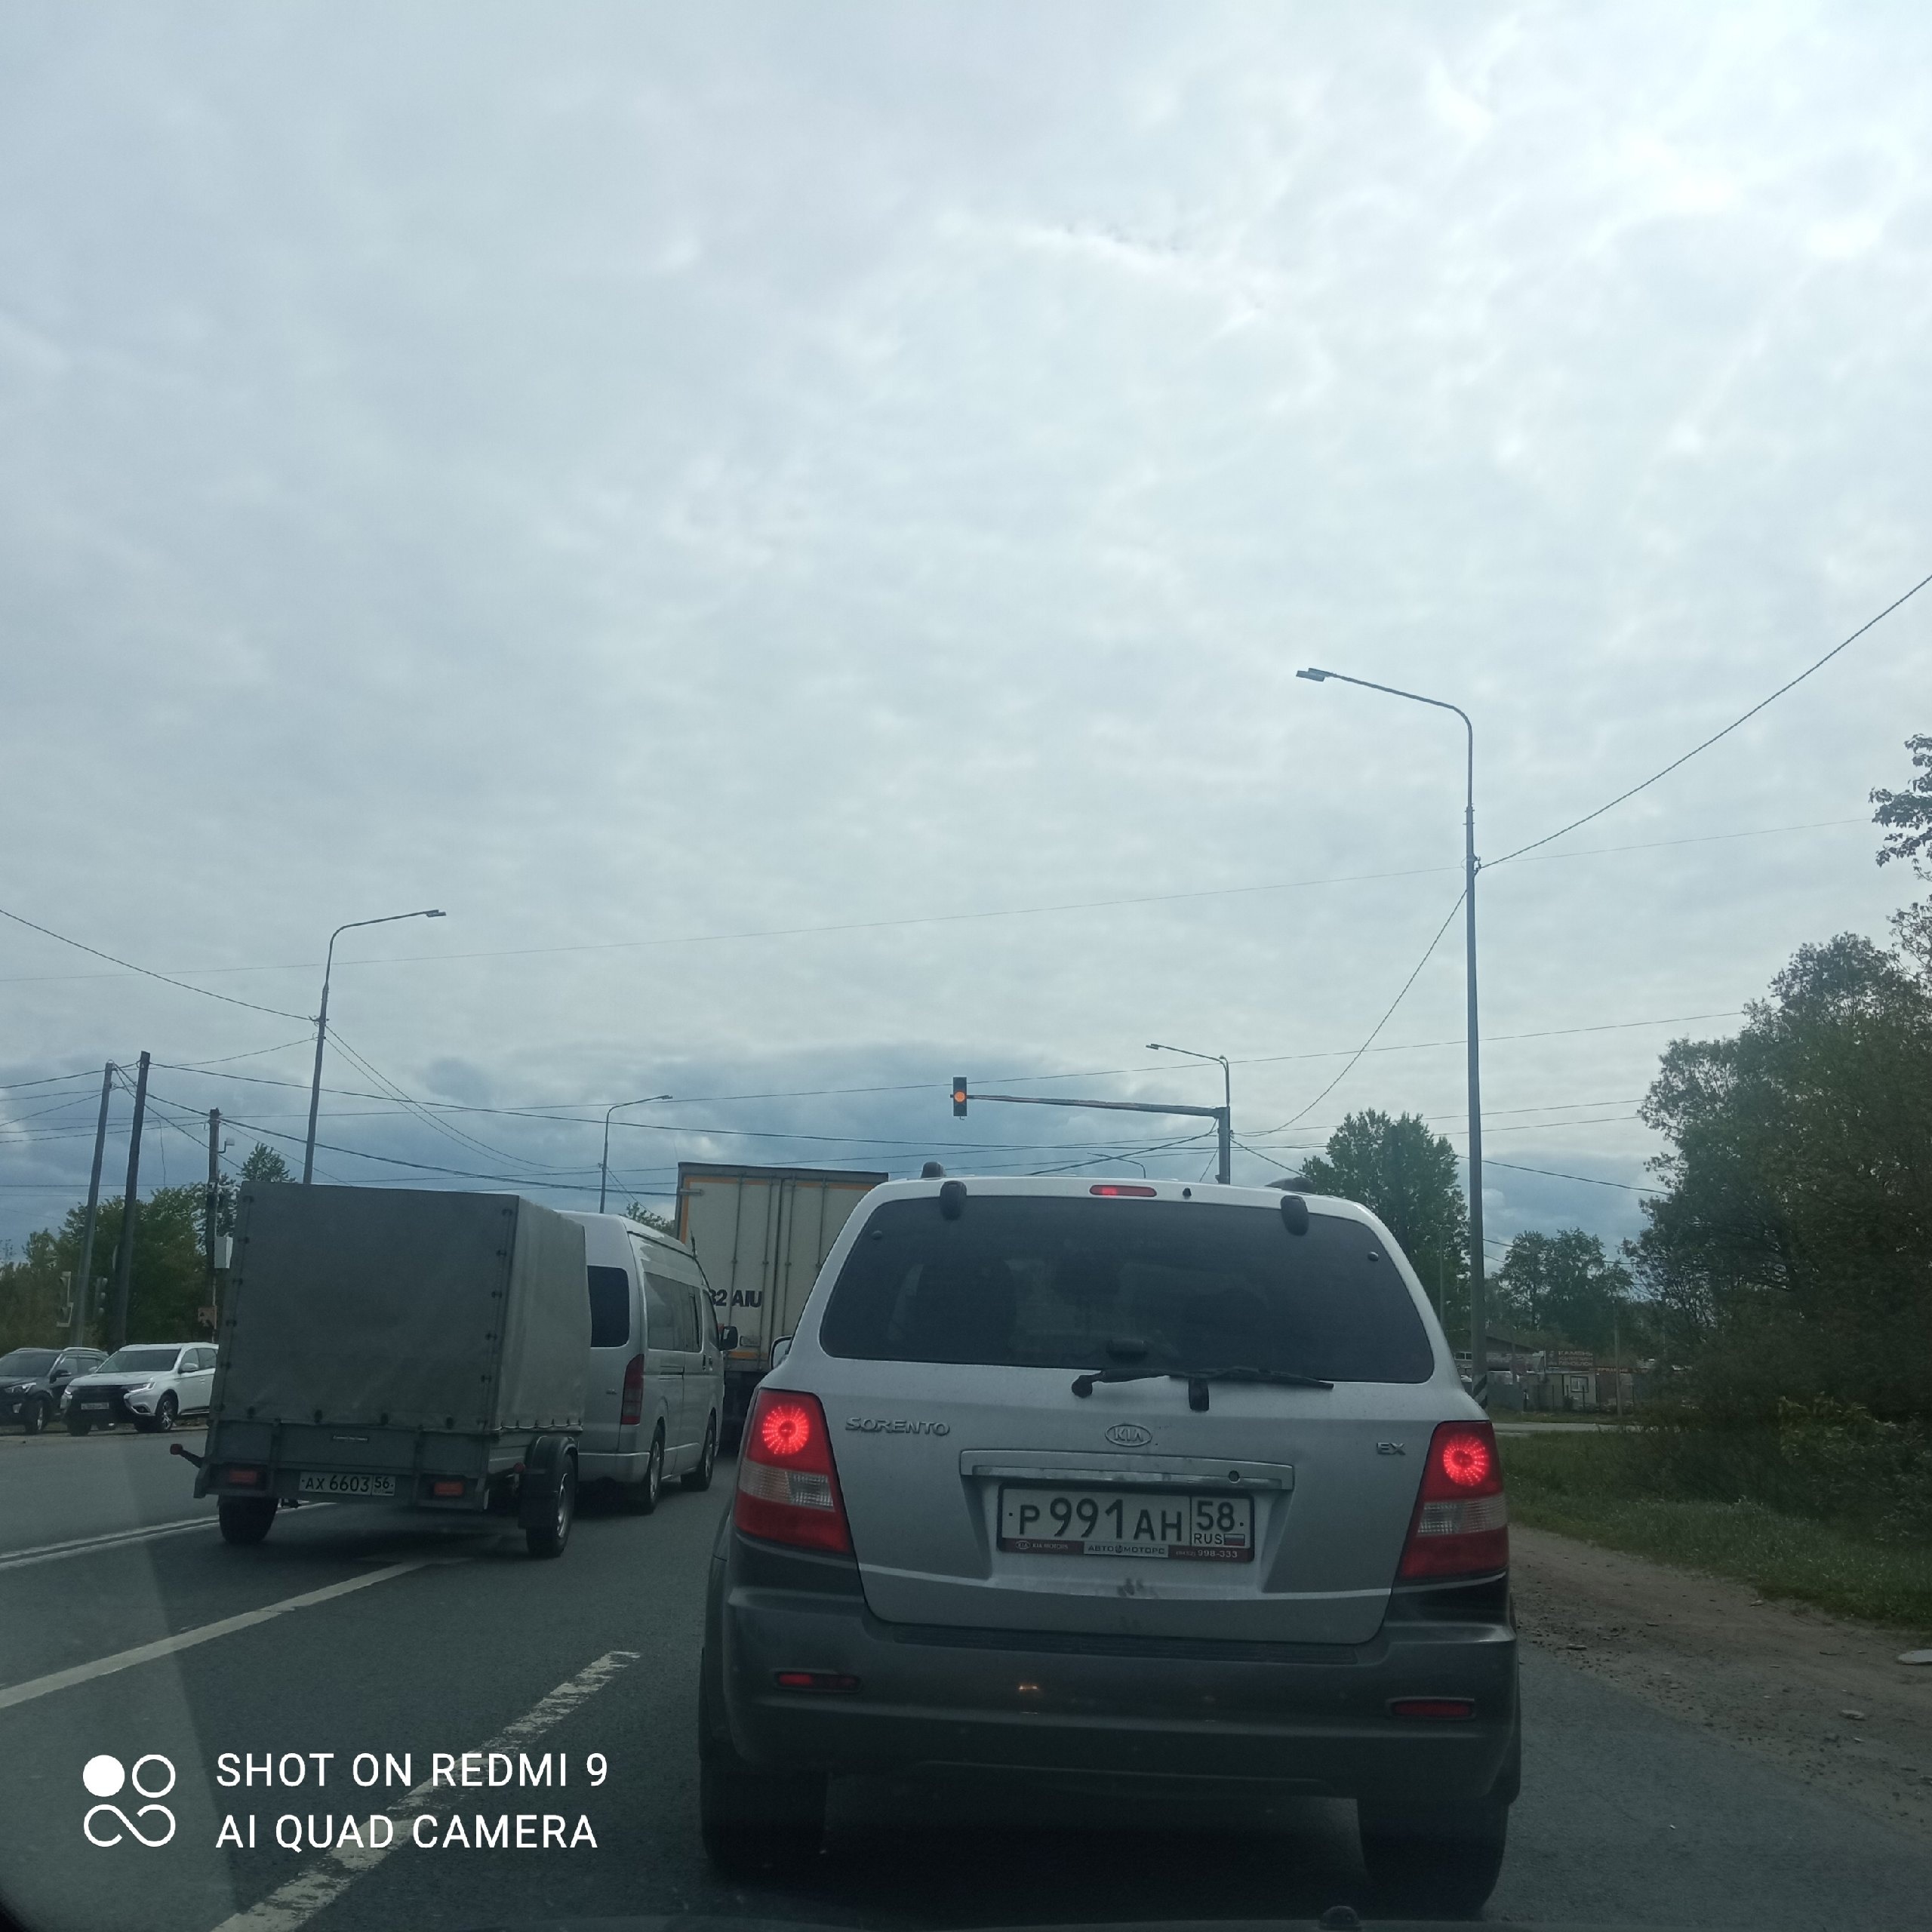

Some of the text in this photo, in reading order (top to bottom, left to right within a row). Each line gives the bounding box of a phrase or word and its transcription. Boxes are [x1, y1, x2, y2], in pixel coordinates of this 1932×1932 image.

[845, 1417, 950, 1437] SORENTO
[1377, 1442, 1406, 1455] EX
[374, 1476, 389, 1489] 56
[1196, 1500, 1235, 1532] 58
[1193, 1533, 1223, 1545] RUS
